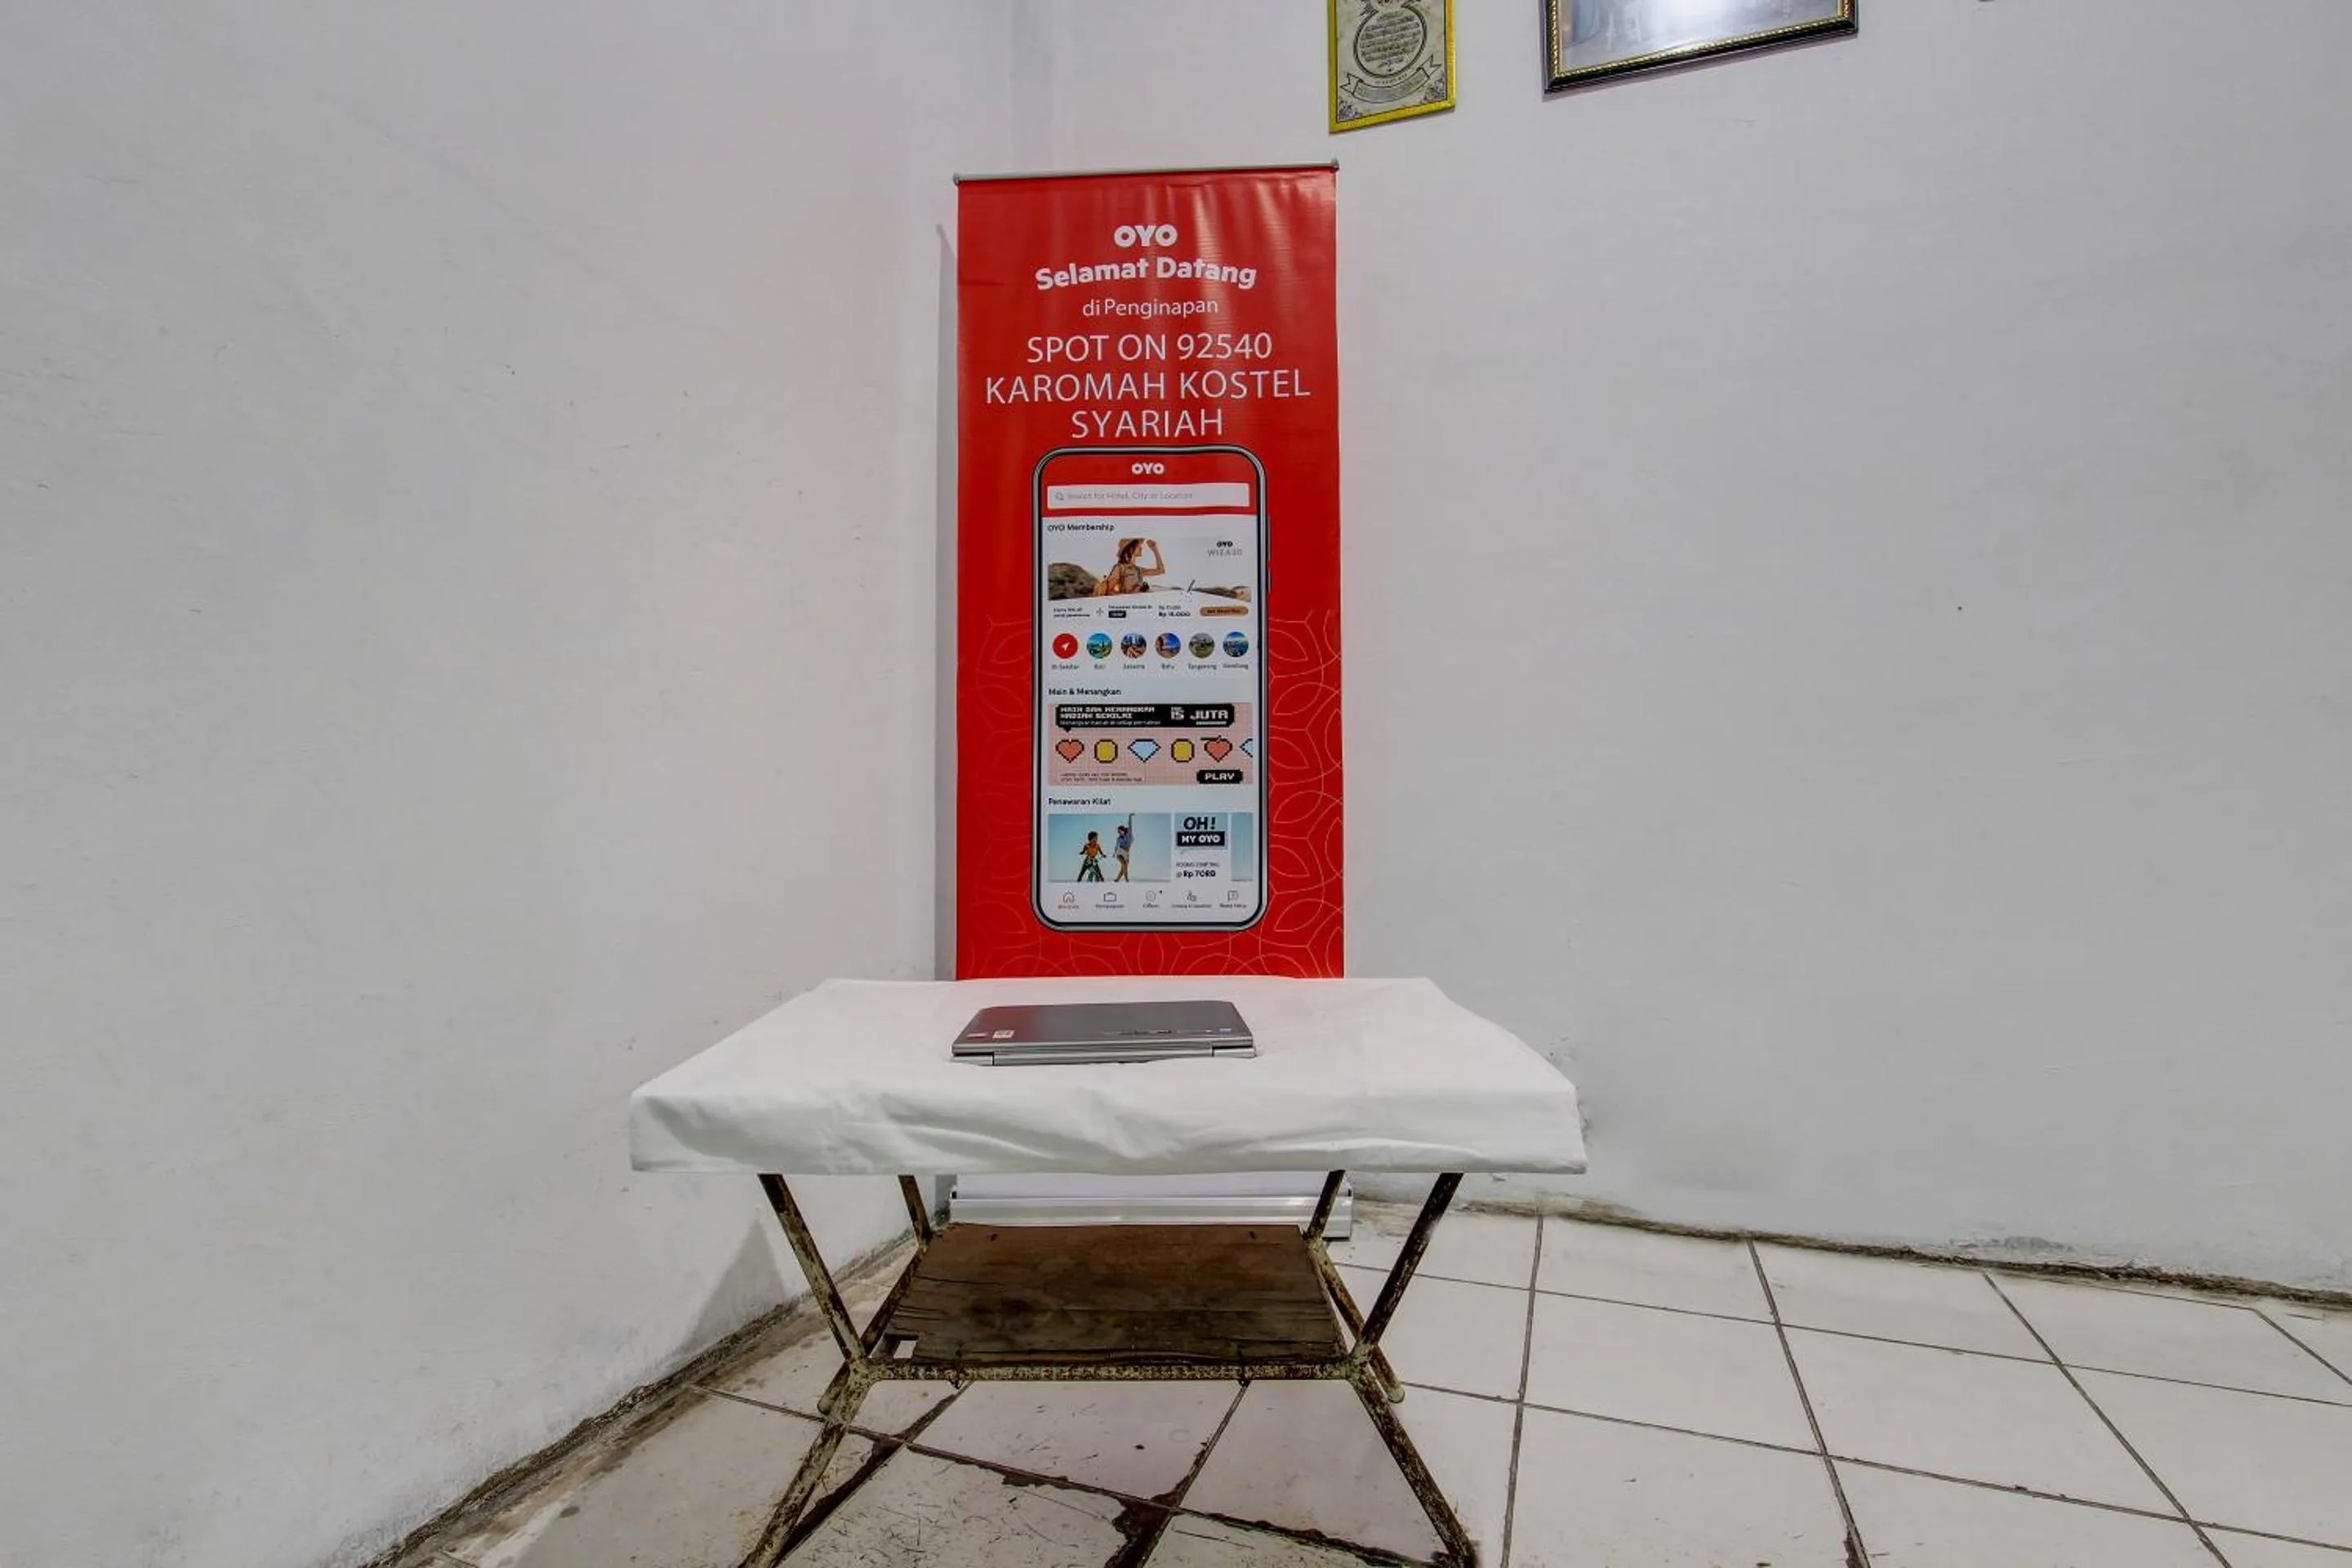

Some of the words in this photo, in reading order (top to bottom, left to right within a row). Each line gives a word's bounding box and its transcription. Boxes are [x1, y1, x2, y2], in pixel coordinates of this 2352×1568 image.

[1114, 224, 1178, 247] OYO
[1035, 256, 1149, 291] Selamat
[1156, 256, 1257, 290] Datang
[1082, 299, 1101, 317] di
[1104, 297, 1218, 319] Penginapan
[1027, 335, 1109, 363] SPOT
[1117, 333, 1167, 362] ON
[1177, 332, 1272, 360] 92540
[985, 373, 1165, 404] KAROMAH
[1180, 368, 1311, 399] KOSTEL
[1071, 408, 1223, 439] SYARIAH
[1131, 462, 1165, 474] OYO
[1067, 523, 1116, 532] Membership
[1216, 540, 1233, 548] OYO
[1048, 688, 1068, 696] Main
[1189, 709, 1229, 720] JUTA
[1205, 772, 1235, 781] PLAY
[1183, 817, 1217, 831] OH!
[1181, 835, 1197, 844] MY
[1198, 835, 1221, 844] OYO
